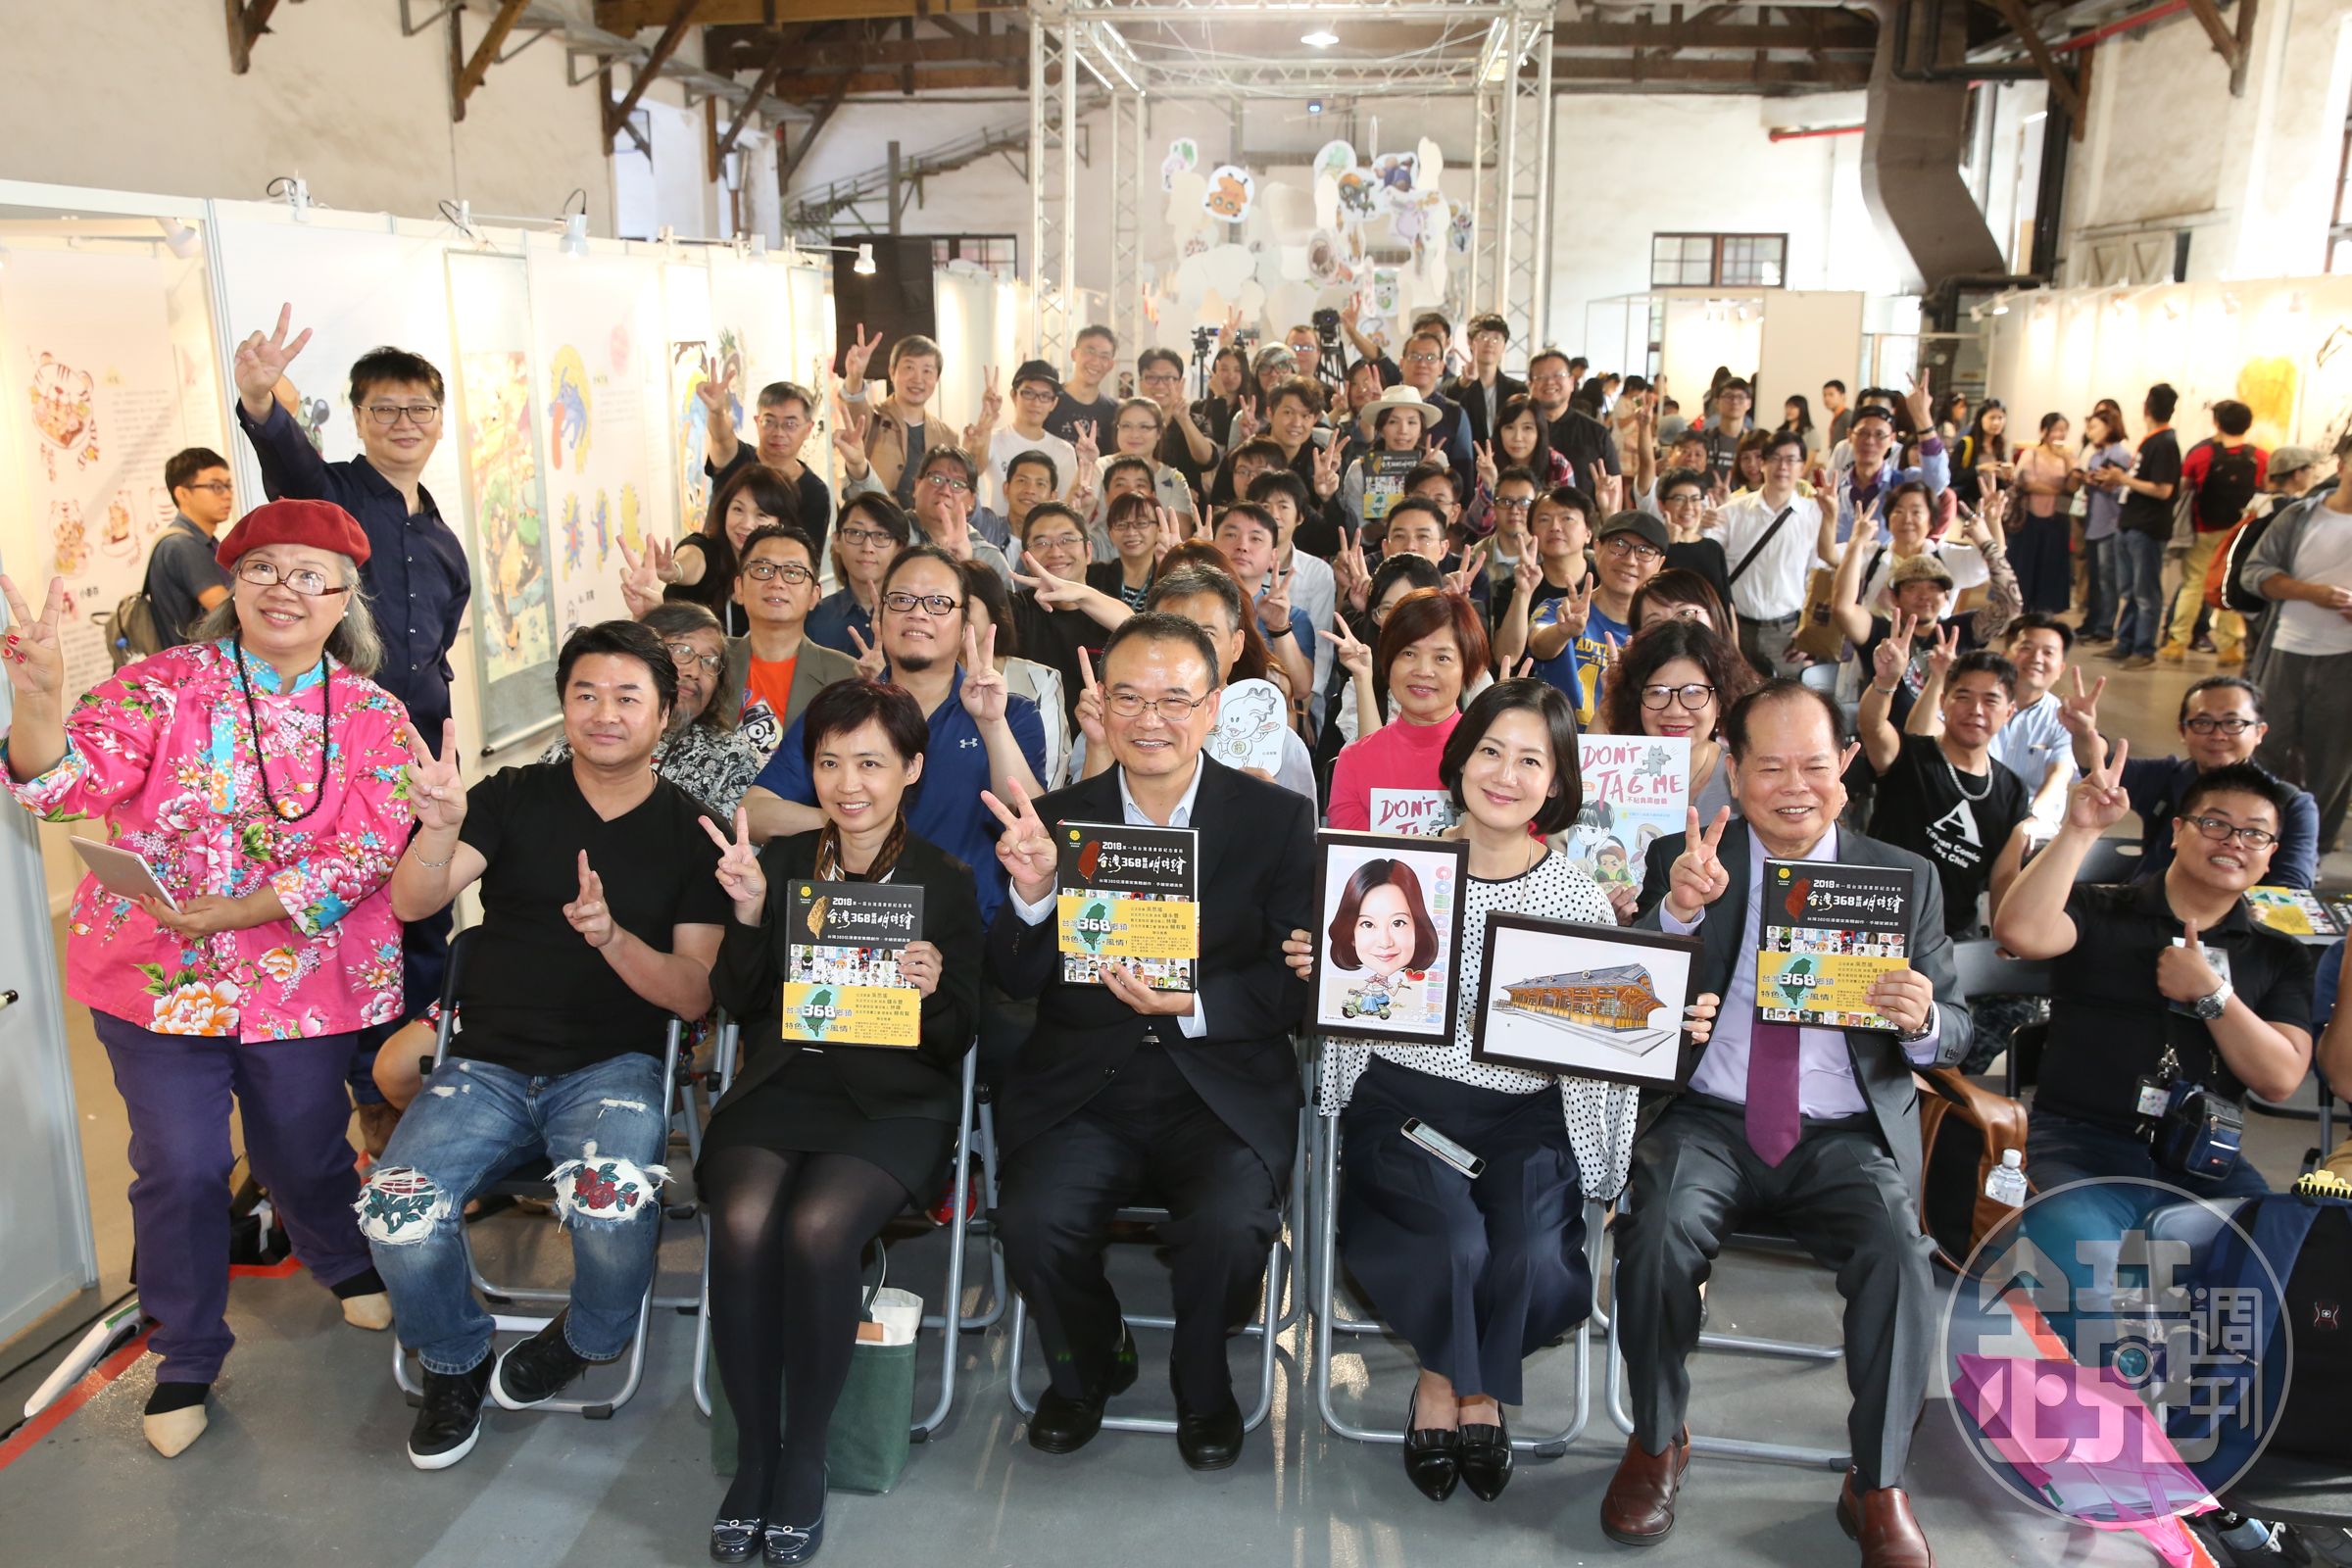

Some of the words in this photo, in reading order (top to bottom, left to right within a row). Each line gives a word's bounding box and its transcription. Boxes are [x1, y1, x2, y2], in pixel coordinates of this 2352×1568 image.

[1597, 769, 1644, 812] TAG
[1653, 774, 1685, 794] ME
[1933, 799, 1984, 848] A
[1953, 844, 1981, 862] Comic
